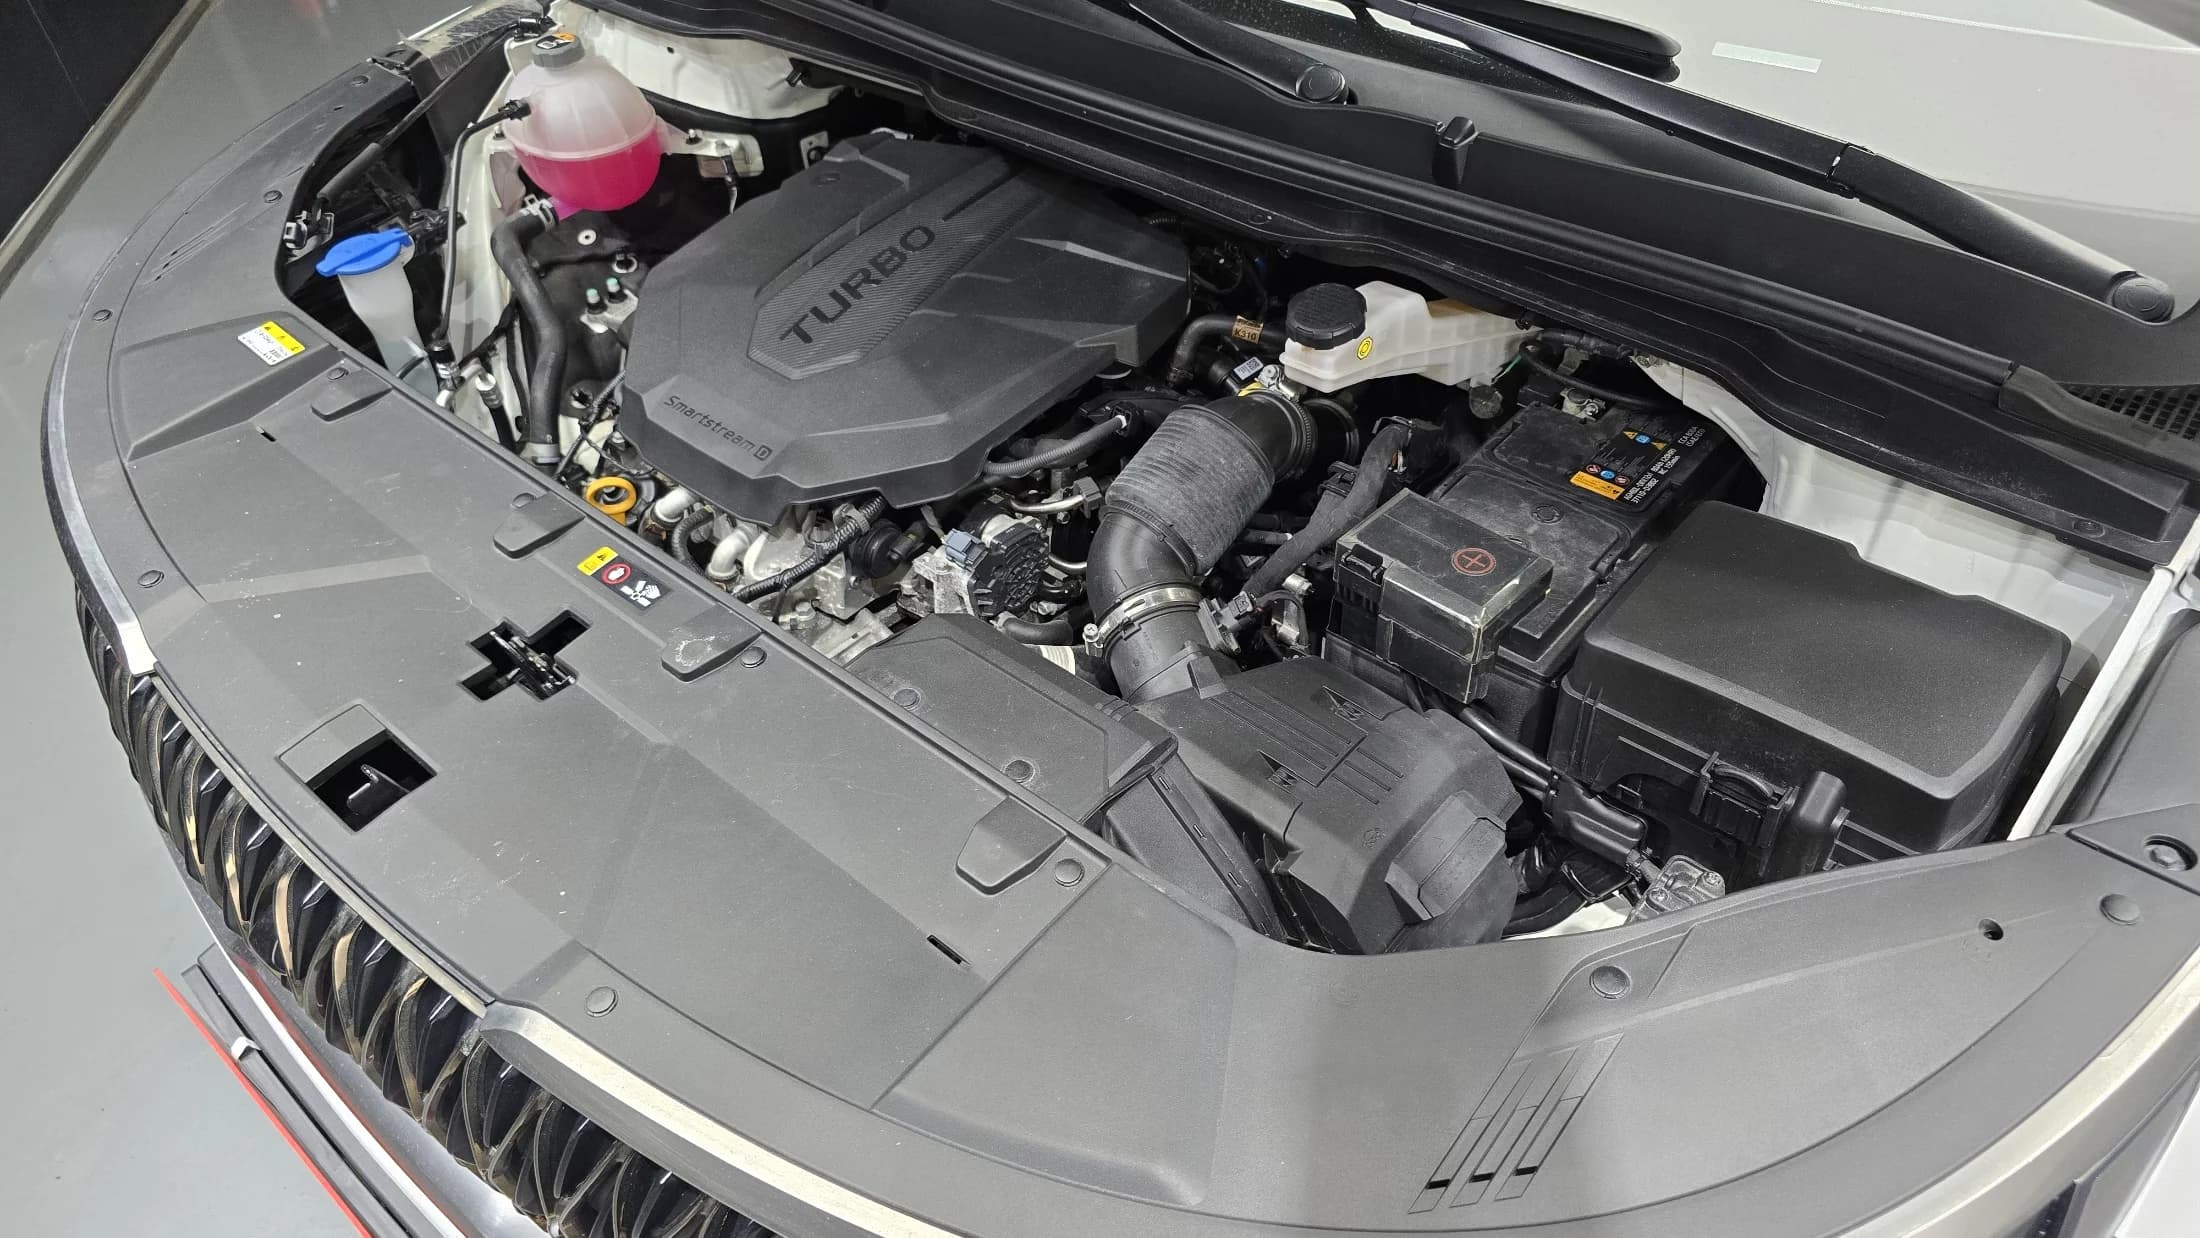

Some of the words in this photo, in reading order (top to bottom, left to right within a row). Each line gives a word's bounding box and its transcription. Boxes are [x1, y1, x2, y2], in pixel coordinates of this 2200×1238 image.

[779, 225, 935, 343] TURBO
[1234, 327, 1257, 341] K310
[664, 395, 755, 452] Smartstream
[753, 444, 773, 461] D
